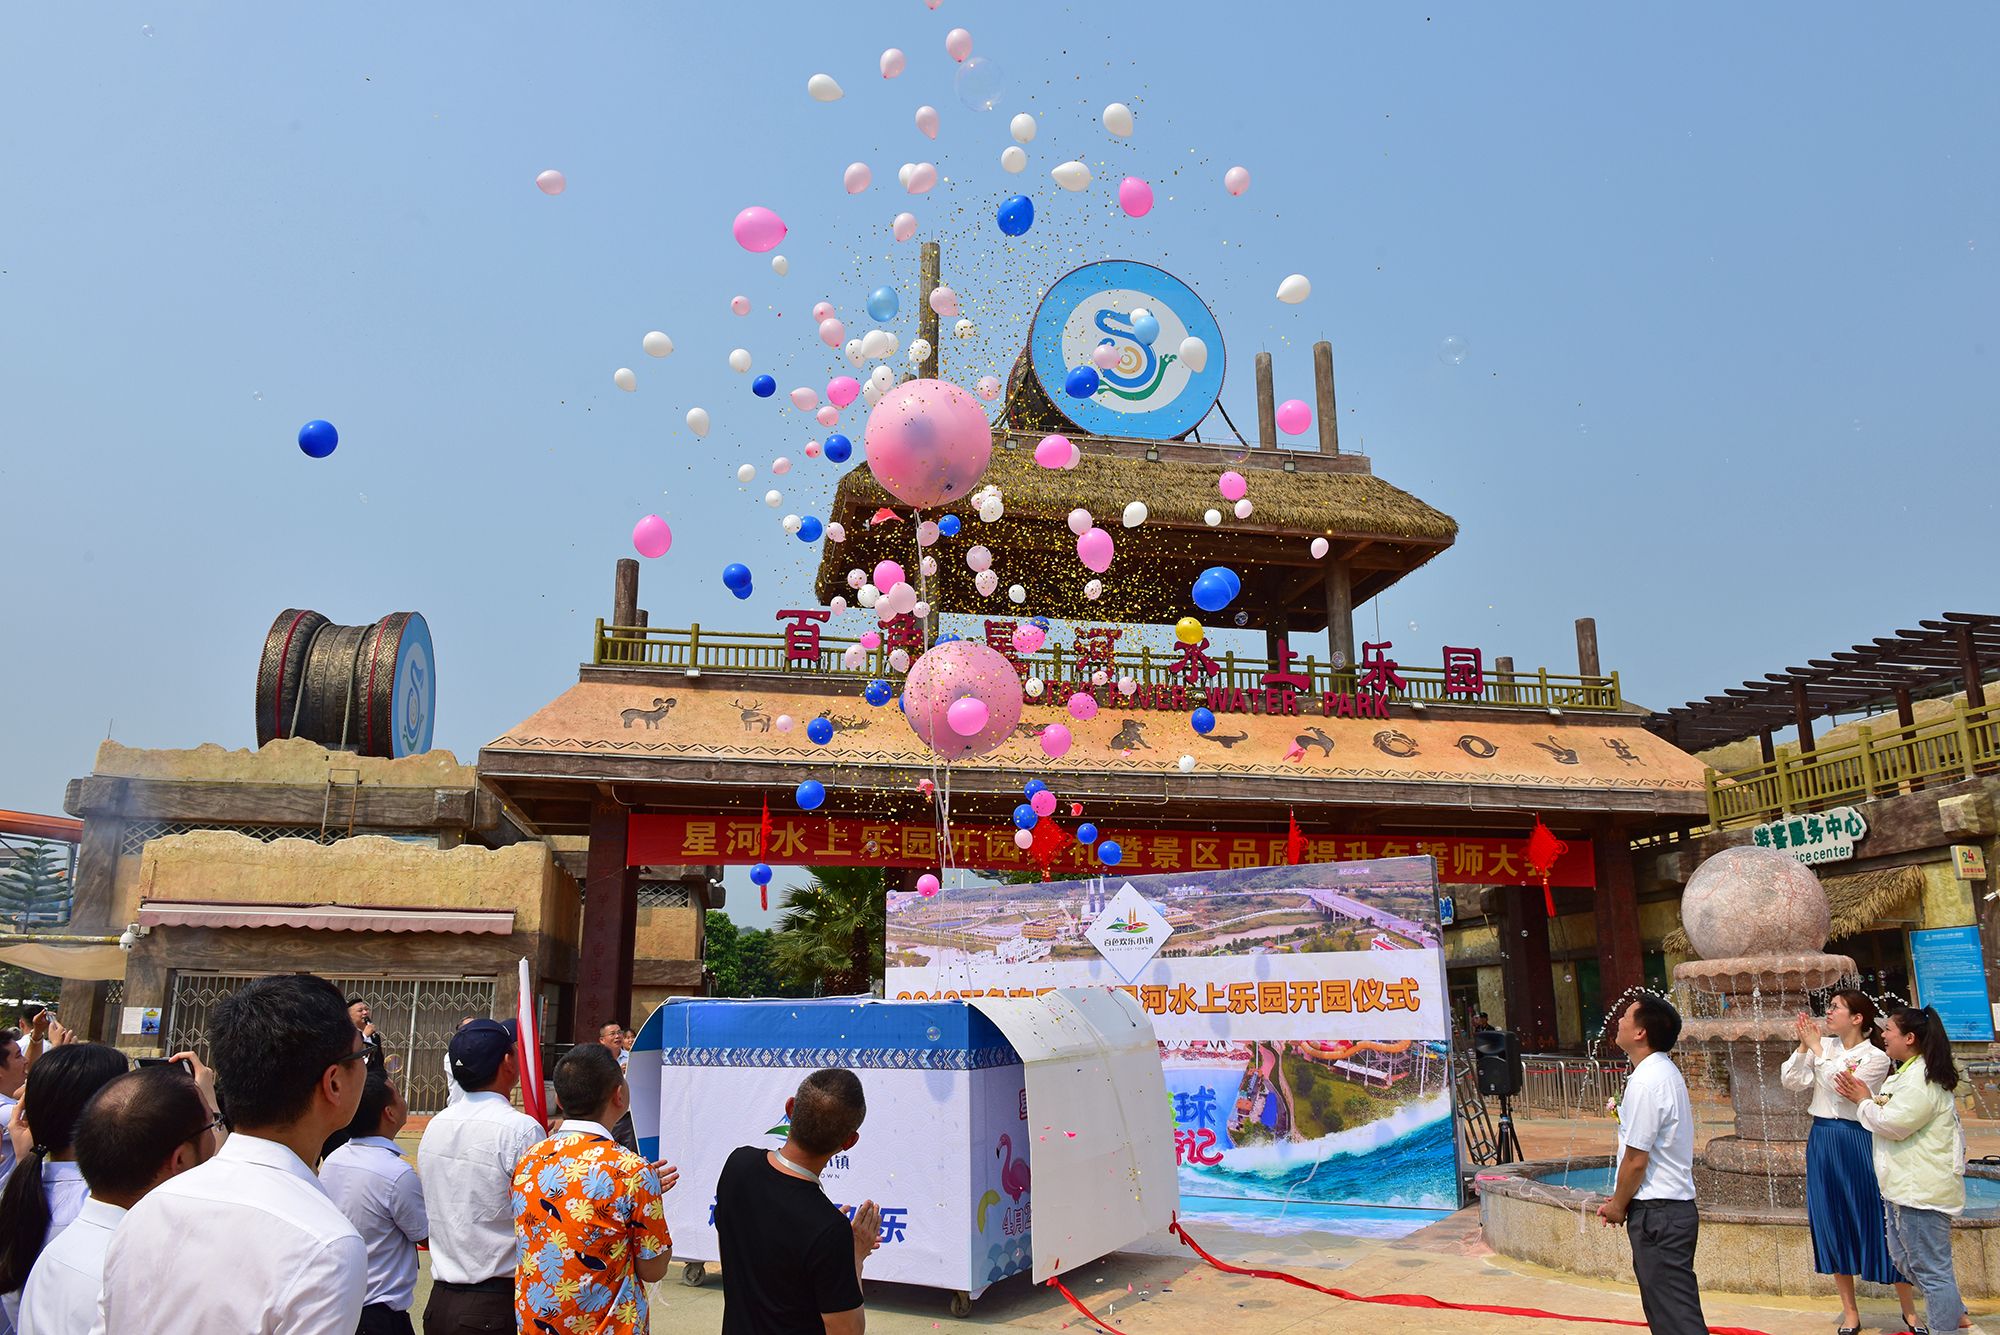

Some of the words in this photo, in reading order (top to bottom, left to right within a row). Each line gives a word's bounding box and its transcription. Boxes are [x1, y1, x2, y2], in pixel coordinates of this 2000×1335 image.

[1108, 682, 1188, 711] RIVER
[1204, 687, 1299, 716] WATER
[1323, 691, 1391, 720] PARK
[681, 820, 1554, 878] 星河水上乐园开园礼暨景区品质提升誓师大
[1754, 811, 1862, 850] 游客服务中心
[1813, 845, 1850, 860] center
[1962, 849, 1975, 863] 24
[1104, 936, 1154, 946] 百色欢乐小镇
[1167, 1085, 1217, 1129] 球
